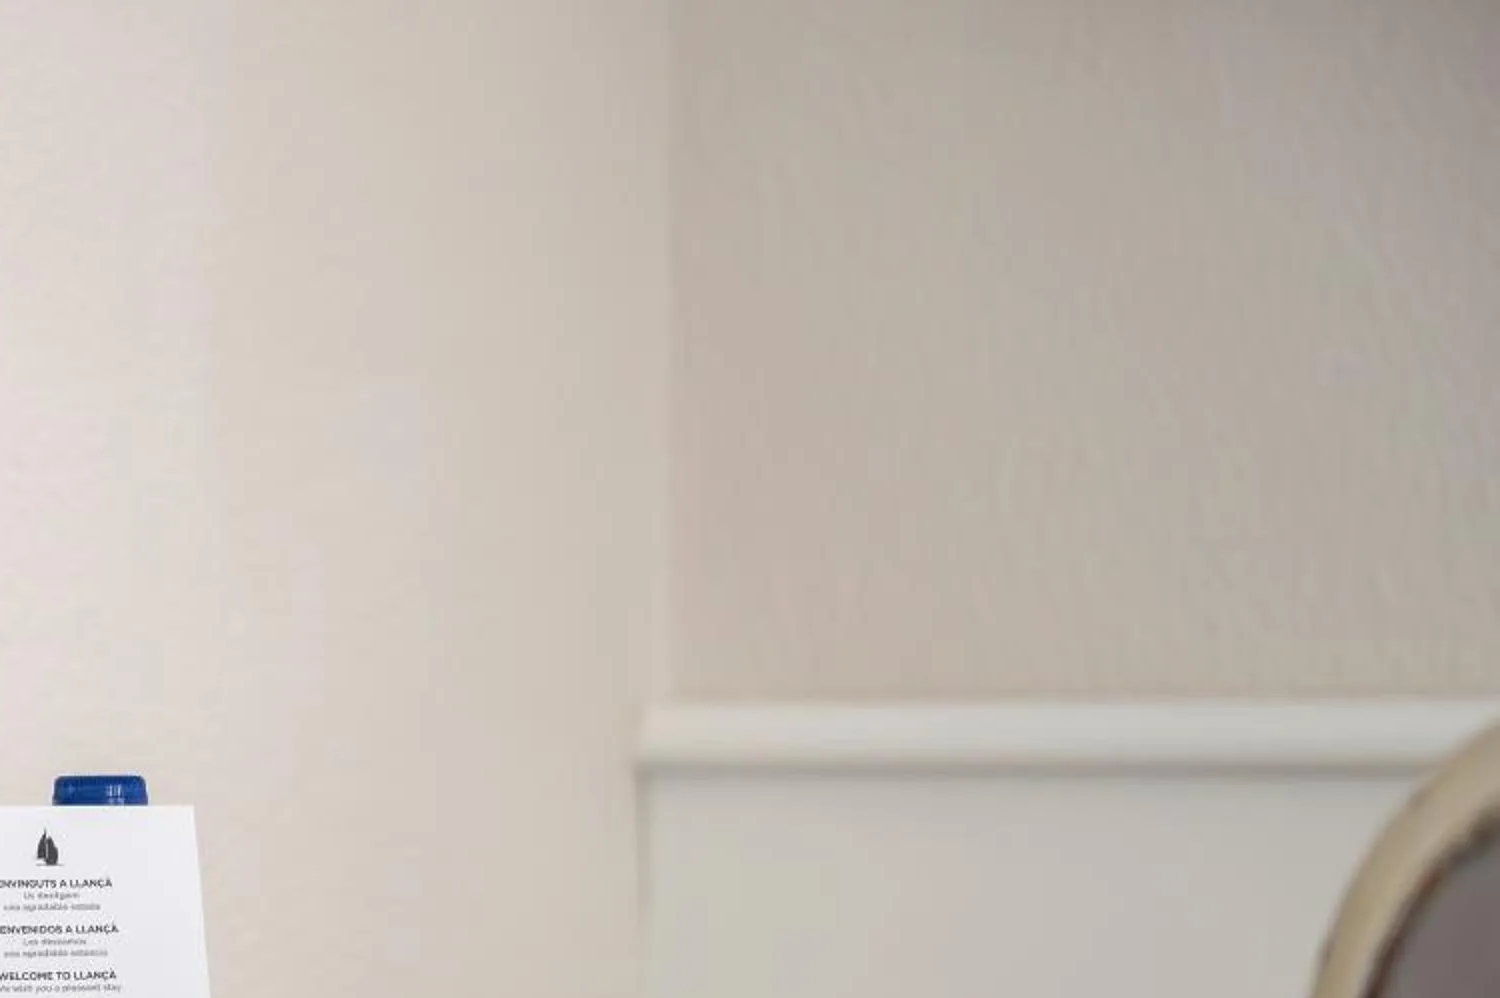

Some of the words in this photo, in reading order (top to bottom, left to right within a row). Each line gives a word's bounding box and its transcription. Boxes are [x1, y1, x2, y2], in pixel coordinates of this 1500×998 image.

[59, 879, 67, 888] A
[65, 925, 73, 933] A
[56, 971, 71, 980] TO
